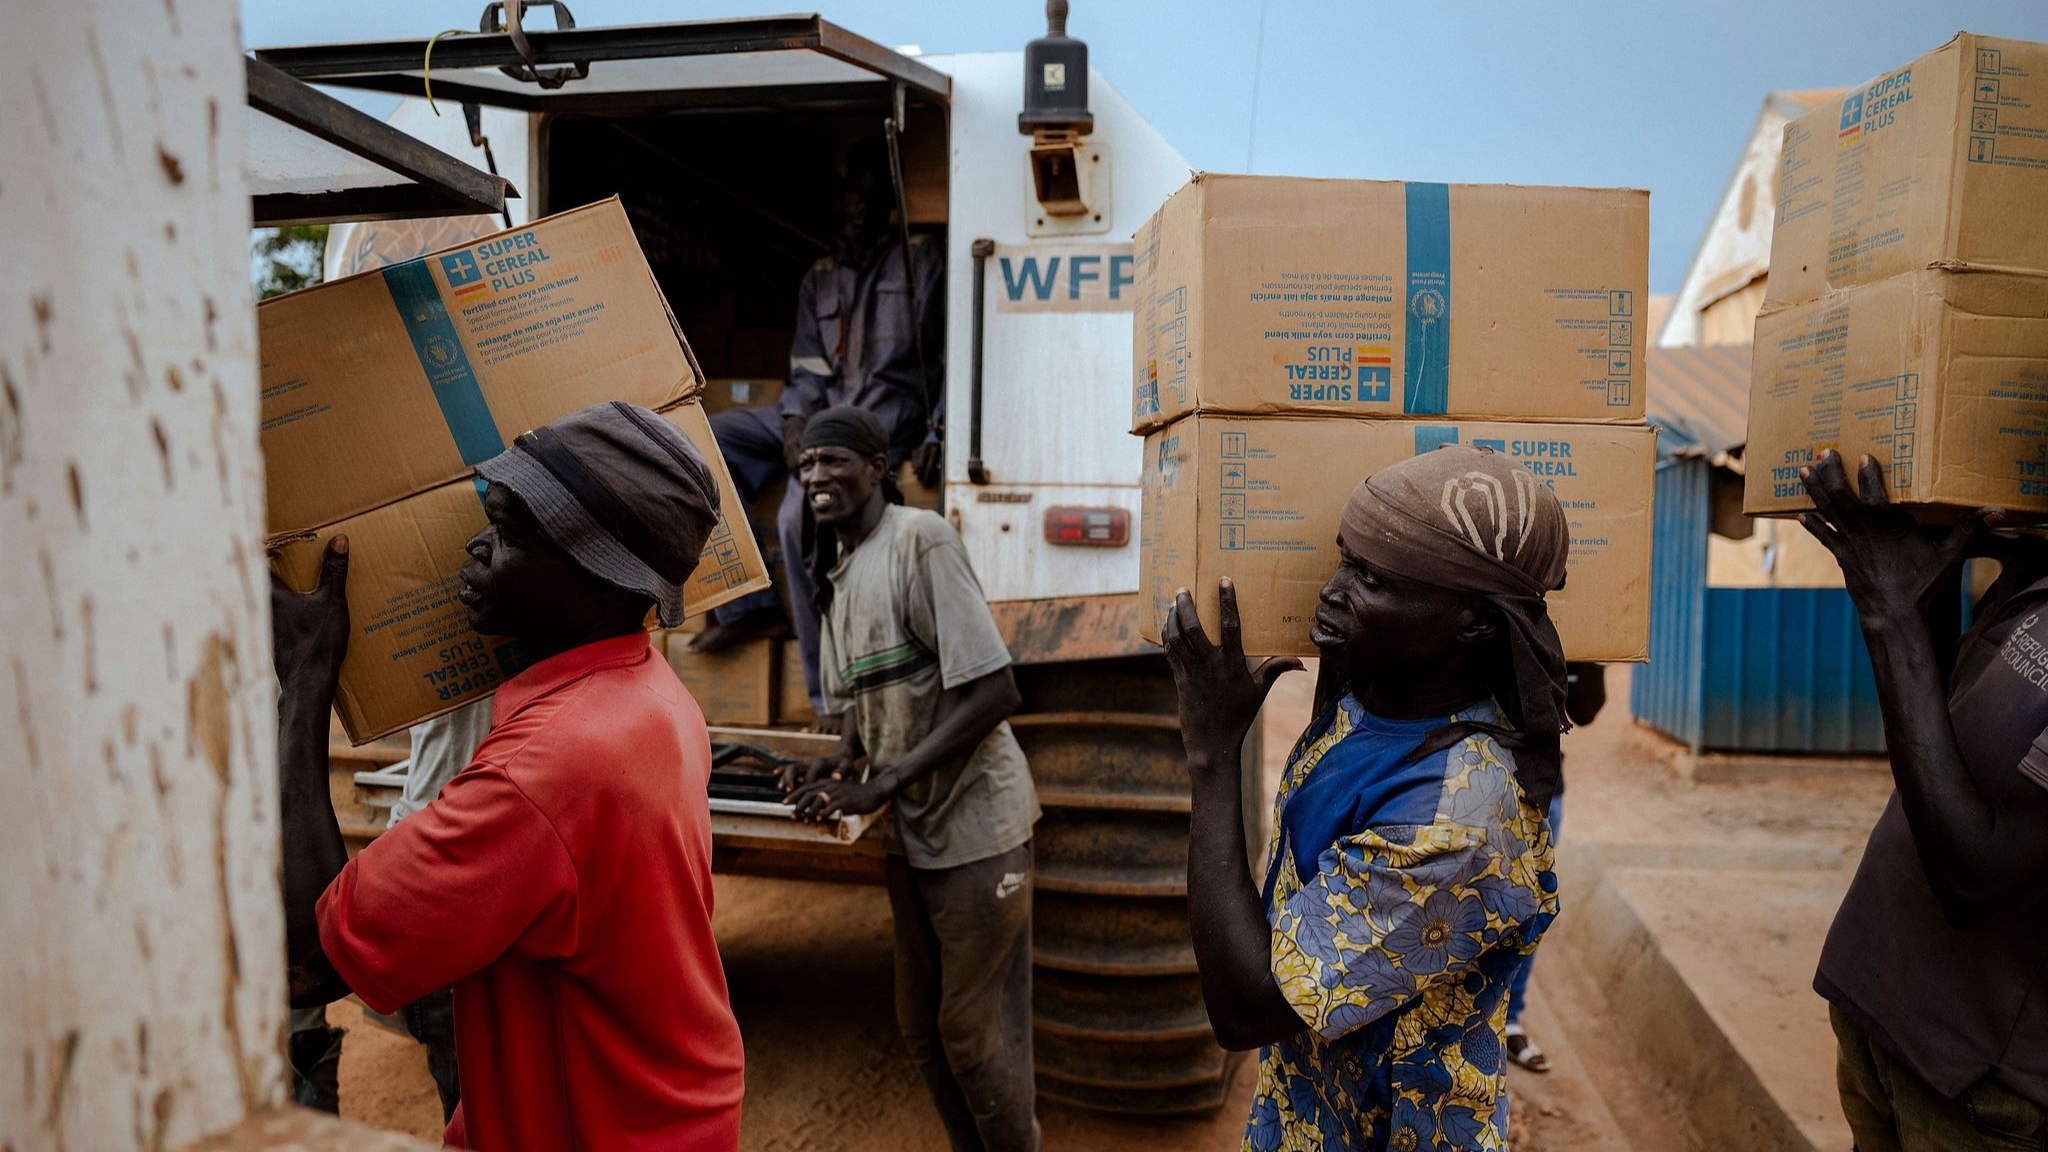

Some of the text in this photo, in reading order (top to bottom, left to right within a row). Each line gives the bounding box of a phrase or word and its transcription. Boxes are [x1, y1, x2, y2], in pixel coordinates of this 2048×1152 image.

[1867, 69, 1911, 101] SUPER
[1866, 87, 1912, 118] CEREAL
[1864, 111, 1894, 135] PLUS
[477, 232, 538, 260] SUPER
[486, 248, 549, 276] CEREAL
[491, 269, 536, 292] PLUS
[1000, 255, 1134, 301] WFP
[1334, 274, 1359, 282] enfants
[1361, 274, 1384, 282] jeunes
[463, 275, 579, 316] fortified corn soya milk blend
[1262, 283, 1302, 291] nourrissons
[1304, 284, 1314, 292] les
[1316, 283, 1332, 291] pour
[1364, 284, 1392, 292] Formule
[1250, 292, 1392, 303] mélange de maïs soja lait enrichi
[466, 294, 551, 326] Special formula for infants
[470, 296, 574, 334] and young children 6-59 months
[1378, 312, 1392, 320] and
[476, 302, 605, 348] mélange de maïs soja lait enrichi
[1338, 322, 1366, 330] formula
[1367, 322, 1392, 330] Special
[480, 344, 508, 357] Formule
[536, 329, 551, 341] pour
[552, 326, 562, 334] les
[1291, 332, 1311, 340] milk
[1312, 331, 1332, 339] soya
[1335, 332, 1354, 340] corn
[1356, 332, 1392, 341] fortified
[484, 358, 492, 366] et
[492, 352, 514, 365] jeunes
[515, 344, 539, 356] enfants
[540, 338, 549, 348] de
[560, 333, 568, 342] 59
[569, 329, 584, 339] mois
[1307, 346, 1352, 363] PLUS
[1285, 364, 1352, 381] CEREAL
[1289, 383, 1352, 401] SUPER
[1511, 441, 1572, 458] SUPER
[1786, 448, 1813, 463] PLUS
[1771, 466, 1798, 481] REAL
[1774, 482, 1805, 497] UPER
[1573, 501, 1595, 509] blend
[1580, 537, 1608, 545] enrichi
[387, 594, 404, 604] mois
[364, 597, 451, 634] maïs soja lait enrichi
[441, 609, 467, 621] hildren
[392, 626, 472, 661] orn soya milk blend
[439, 637, 483, 663] PLUS
[2016, 632, 2048, 670] REFUG
[424, 652, 489, 685] CEREAL
[2004, 647, 2048, 692] COUNCIL
[435, 668, 497, 701] SUPER
